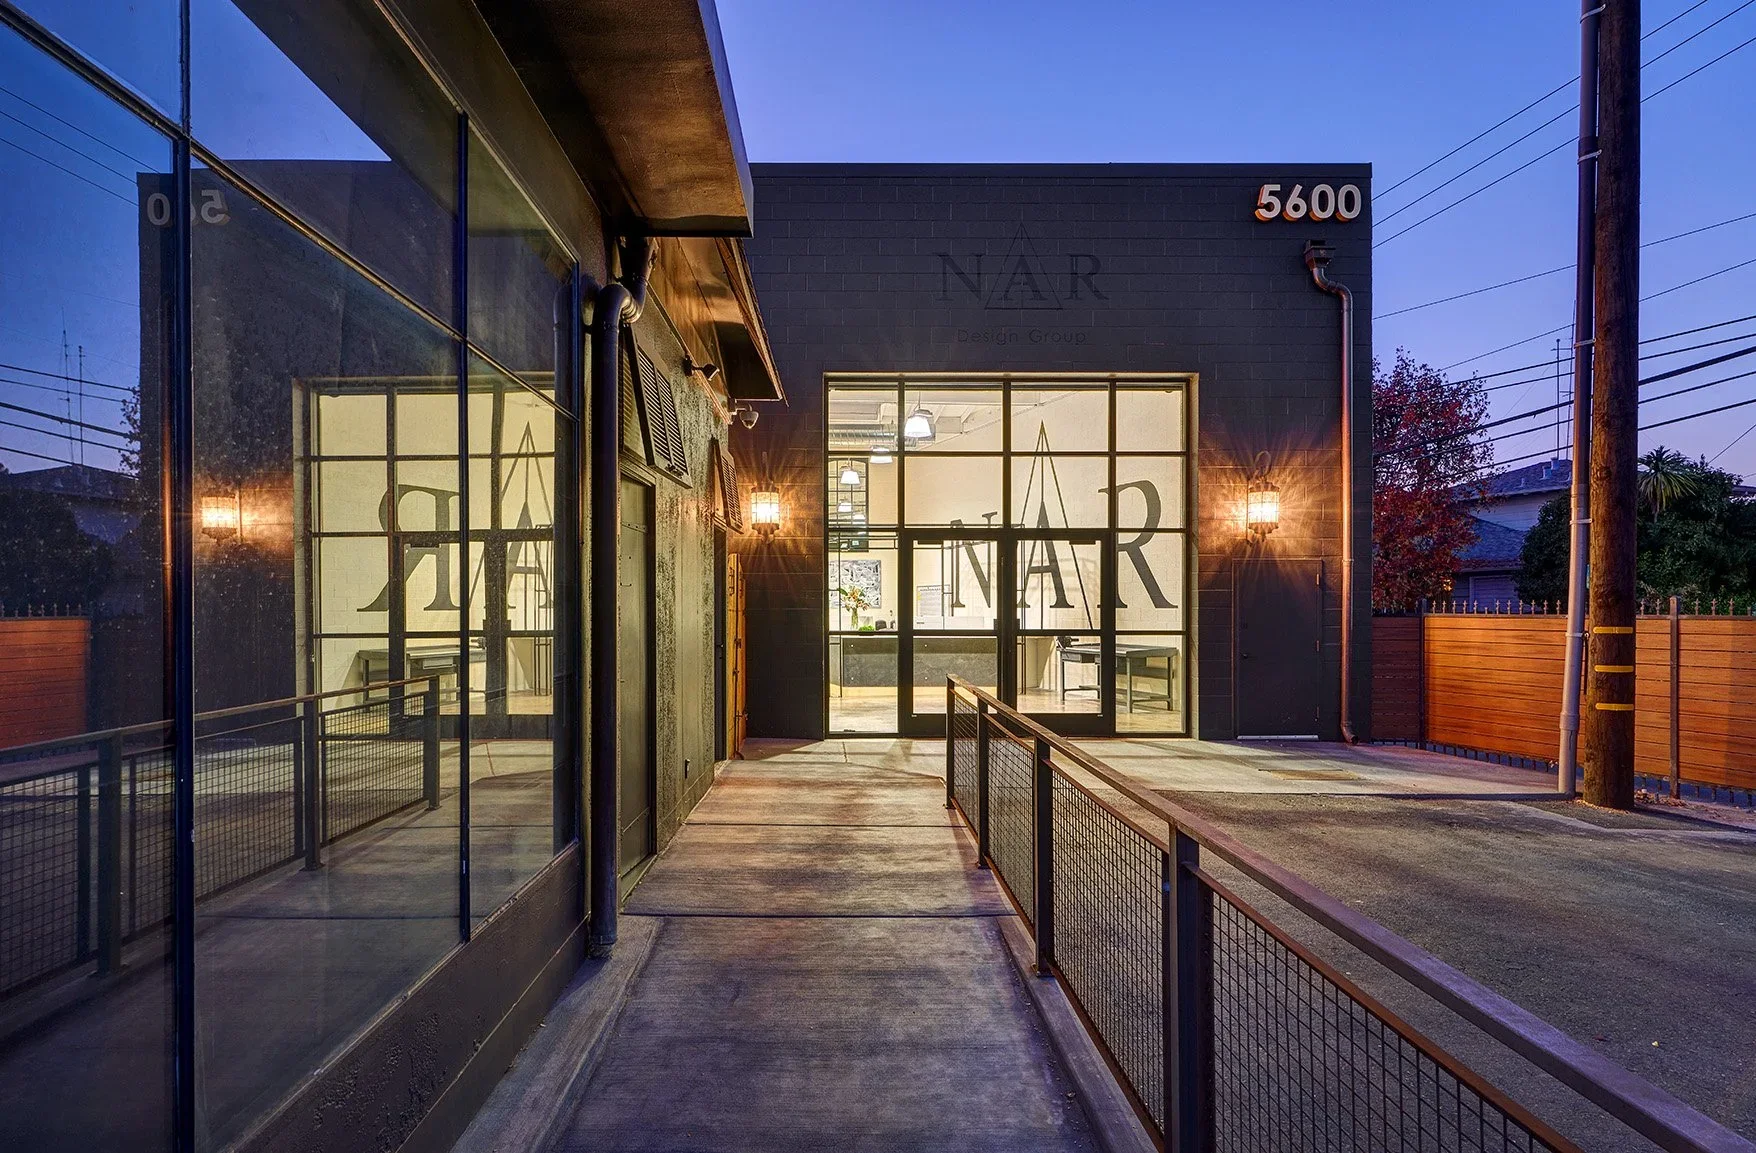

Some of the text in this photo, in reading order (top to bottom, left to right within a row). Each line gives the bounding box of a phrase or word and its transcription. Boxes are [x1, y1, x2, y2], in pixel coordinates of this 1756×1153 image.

[1256, 183, 1362, 220] 5600
[933, 253, 1109, 301] NAR
[957, 329, 1086, 346] Design Group
[950, 480, 1178, 609] NAR
